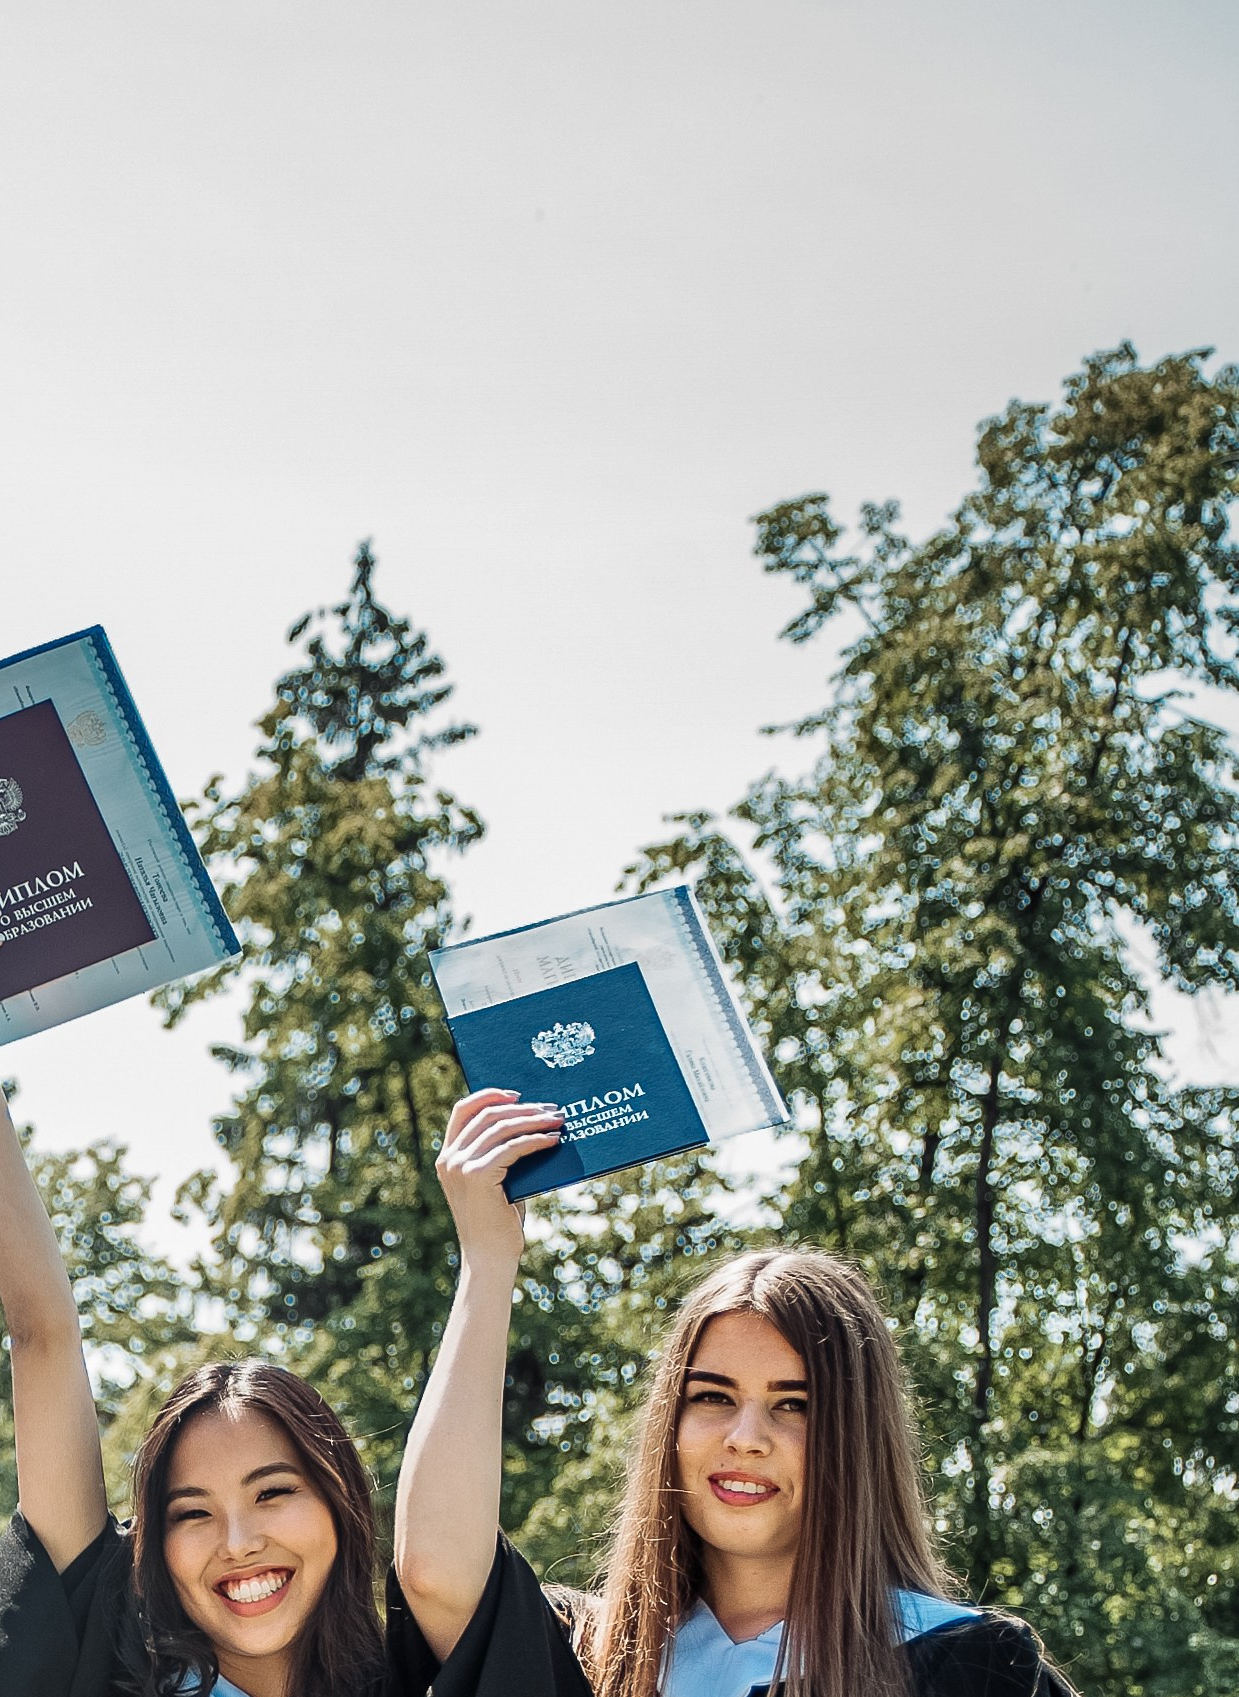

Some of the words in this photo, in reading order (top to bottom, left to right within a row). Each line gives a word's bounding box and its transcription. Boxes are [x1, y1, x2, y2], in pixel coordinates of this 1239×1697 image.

[0, 915, 11, 926] О
[13, 888, 77, 920] ВЫСШЕМ
[3, 897, 93, 941] БРАЗОВАНИИ
[560, 1110, 649, 1143] РАЗОВАНИИ
[564, 1104, 633, 1131] ВЫСШЕМ
